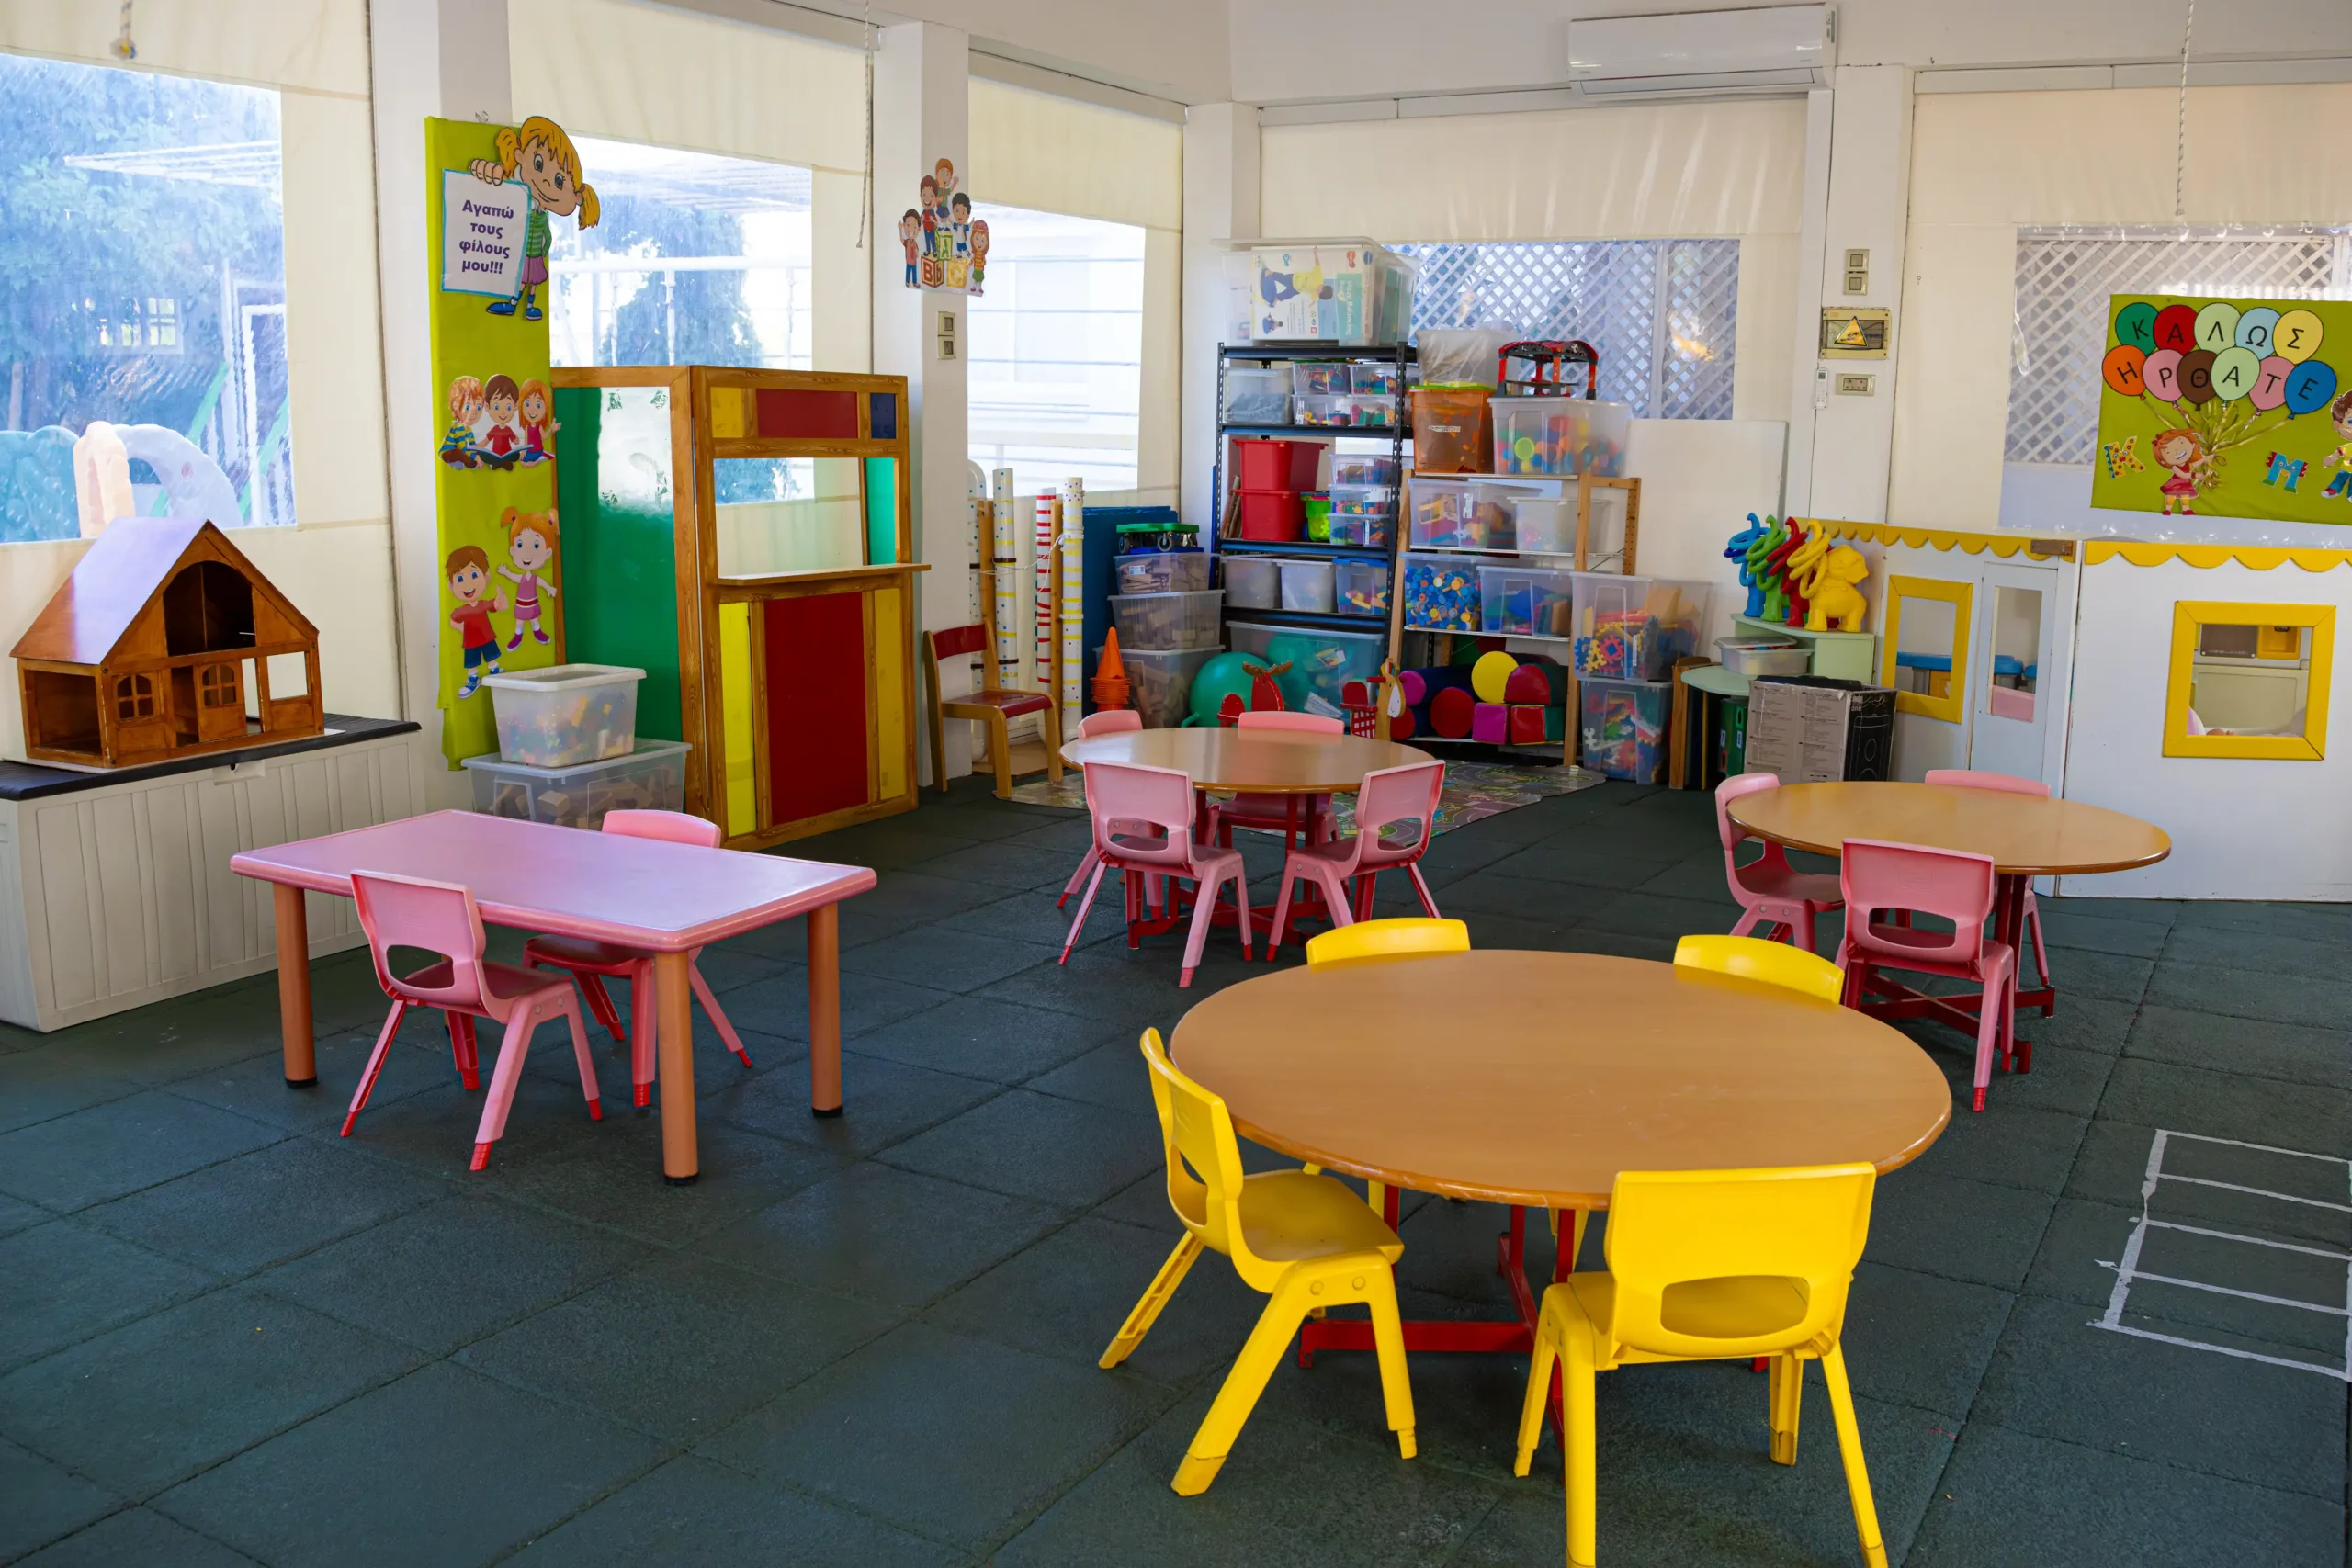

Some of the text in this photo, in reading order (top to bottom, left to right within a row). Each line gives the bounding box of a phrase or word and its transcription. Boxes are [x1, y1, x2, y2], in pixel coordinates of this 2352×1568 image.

[461, 199, 514, 220] Αγαπώ
[469, 222, 503, 239] τους
[458, 240, 510, 259] φίλους
[461, 260, 503, 274] μου!!!
[923, 261, 933, 283] B
